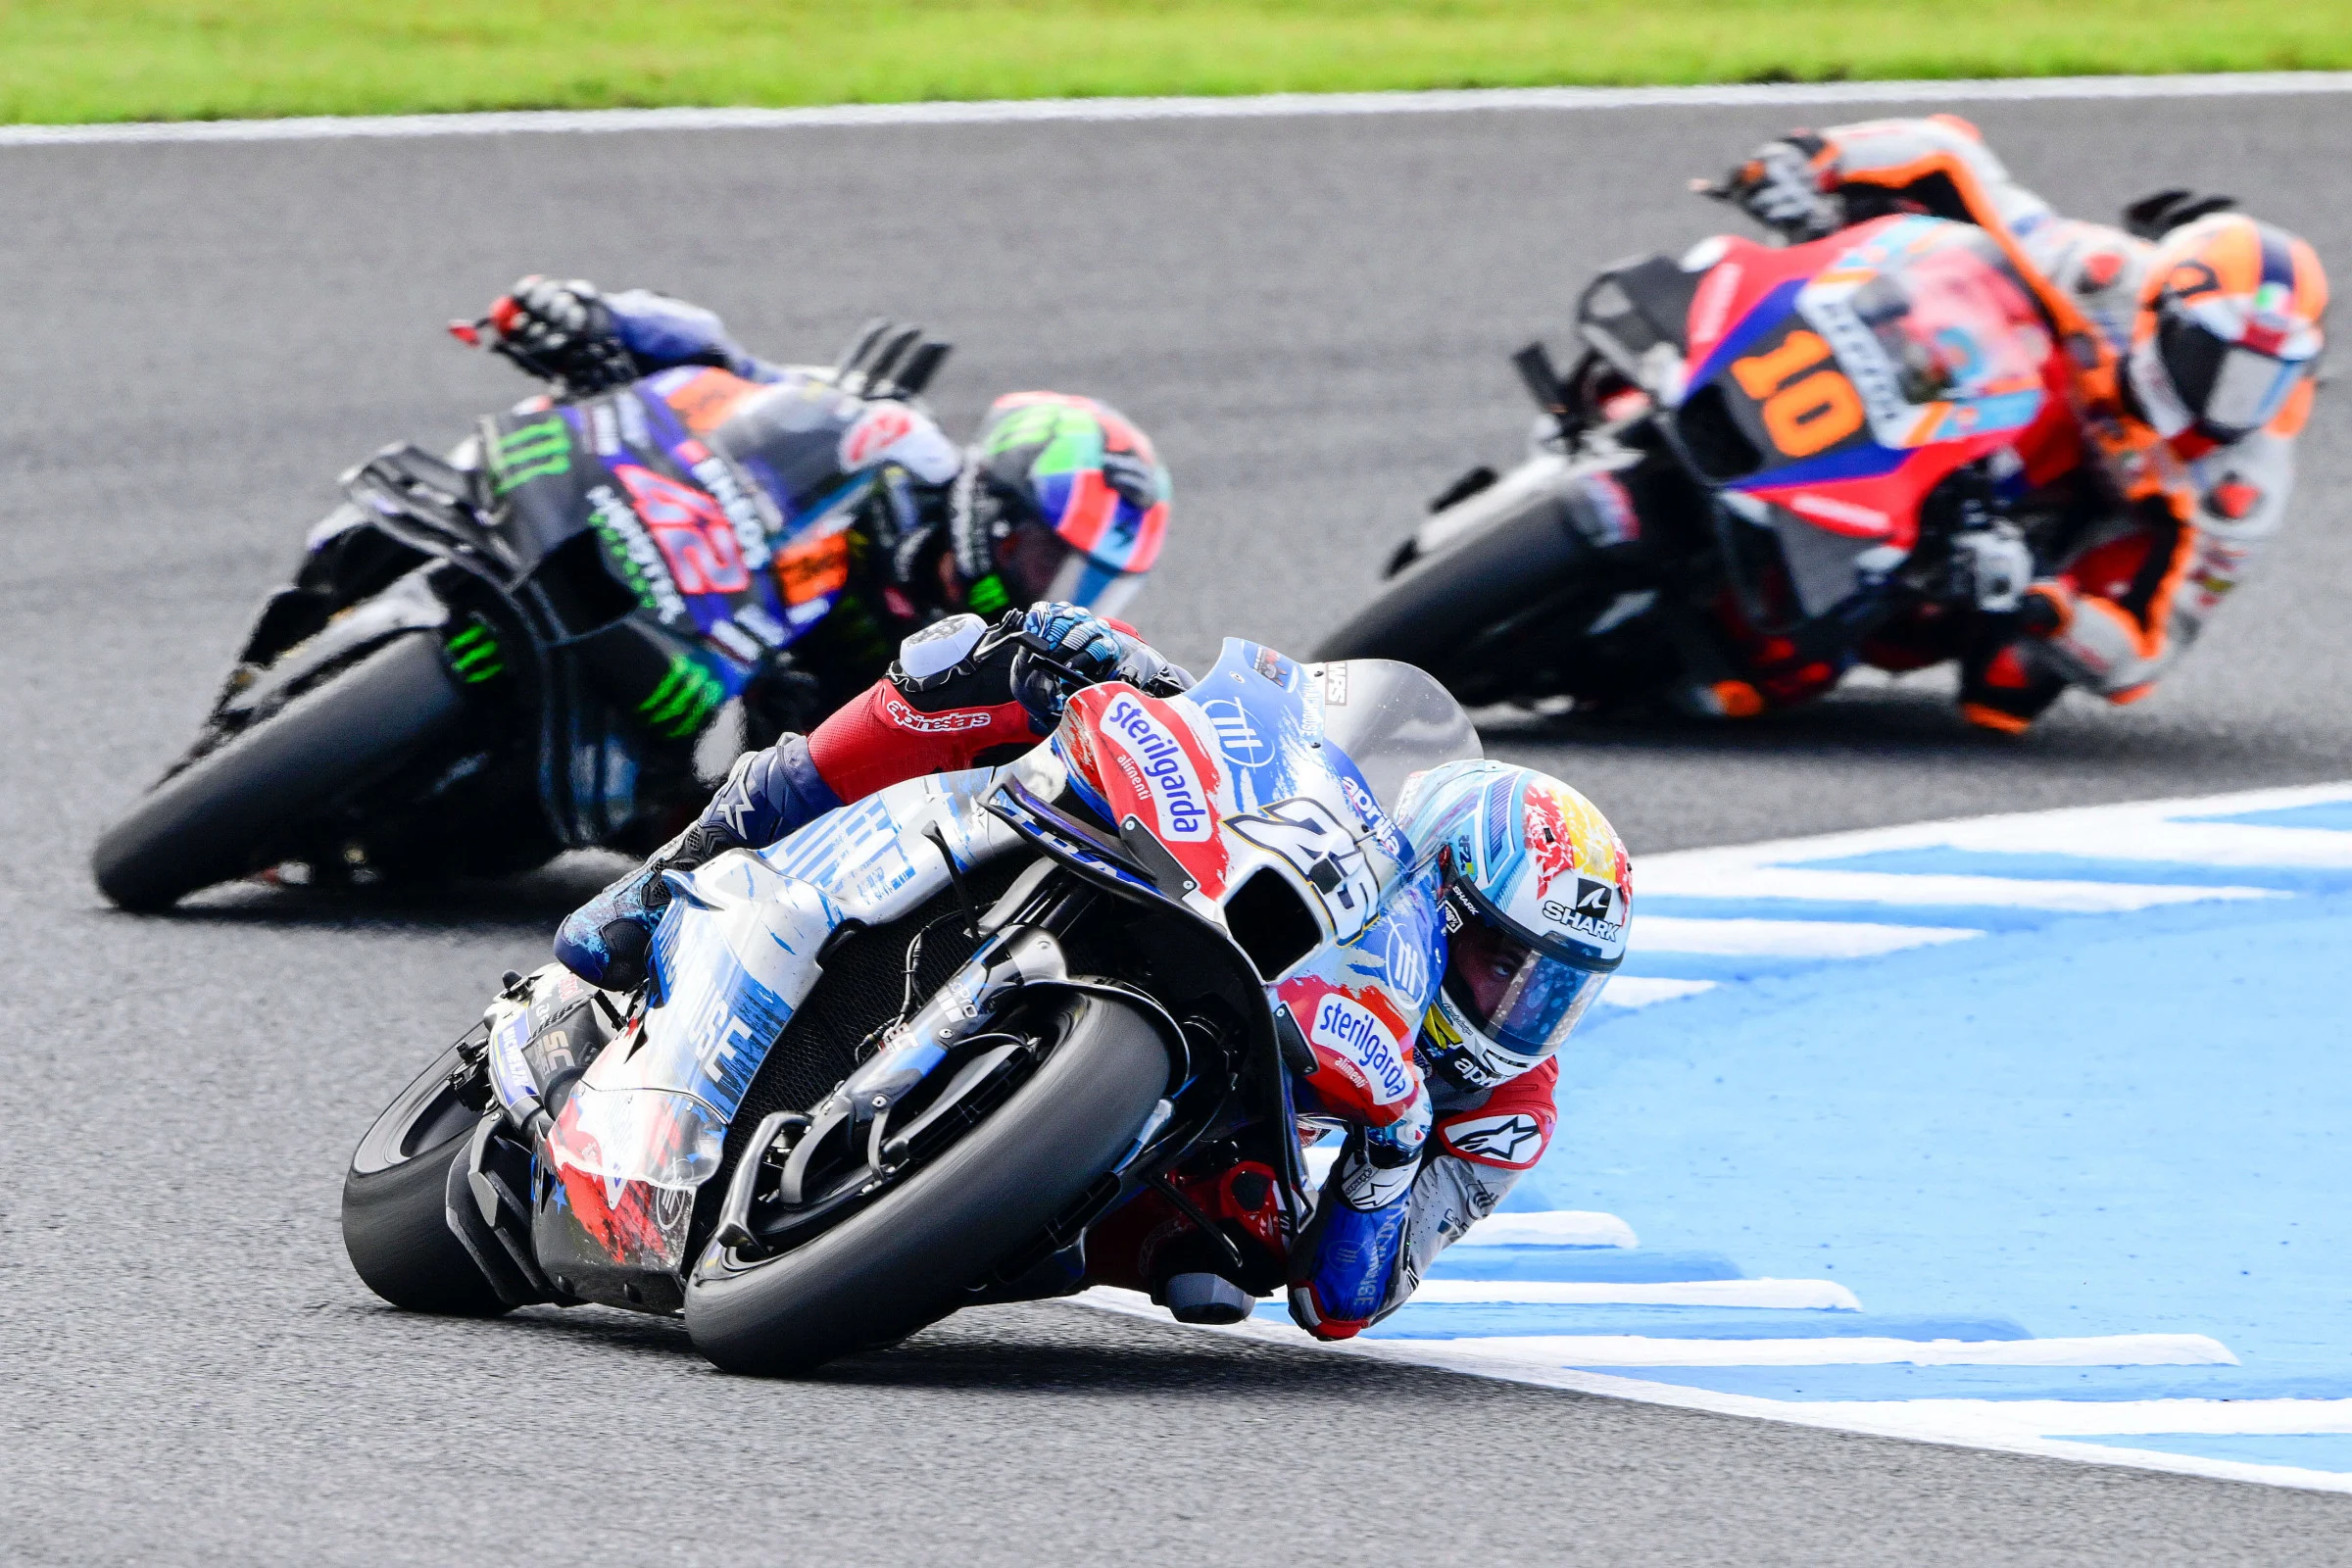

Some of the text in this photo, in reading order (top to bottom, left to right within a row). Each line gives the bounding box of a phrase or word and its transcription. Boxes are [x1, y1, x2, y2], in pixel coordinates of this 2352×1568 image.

[1730, 329, 1866, 458] 10
[1328, 662, 1346, 703] WRS
[1108, 700, 1206, 833] sterilgarda
[1116, 754, 1152, 801] alimenti
[1452, 886, 1479, 916] SHARK
[1543, 900, 1622, 943] SHARK
[501, 1025, 530, 1087] MICHELIN
[543, 1029, 575, 1069] SC
[1319, 1003, 1407, 1099] sterilgarda
[1334, 1055, 1369, 1089] alimenti
